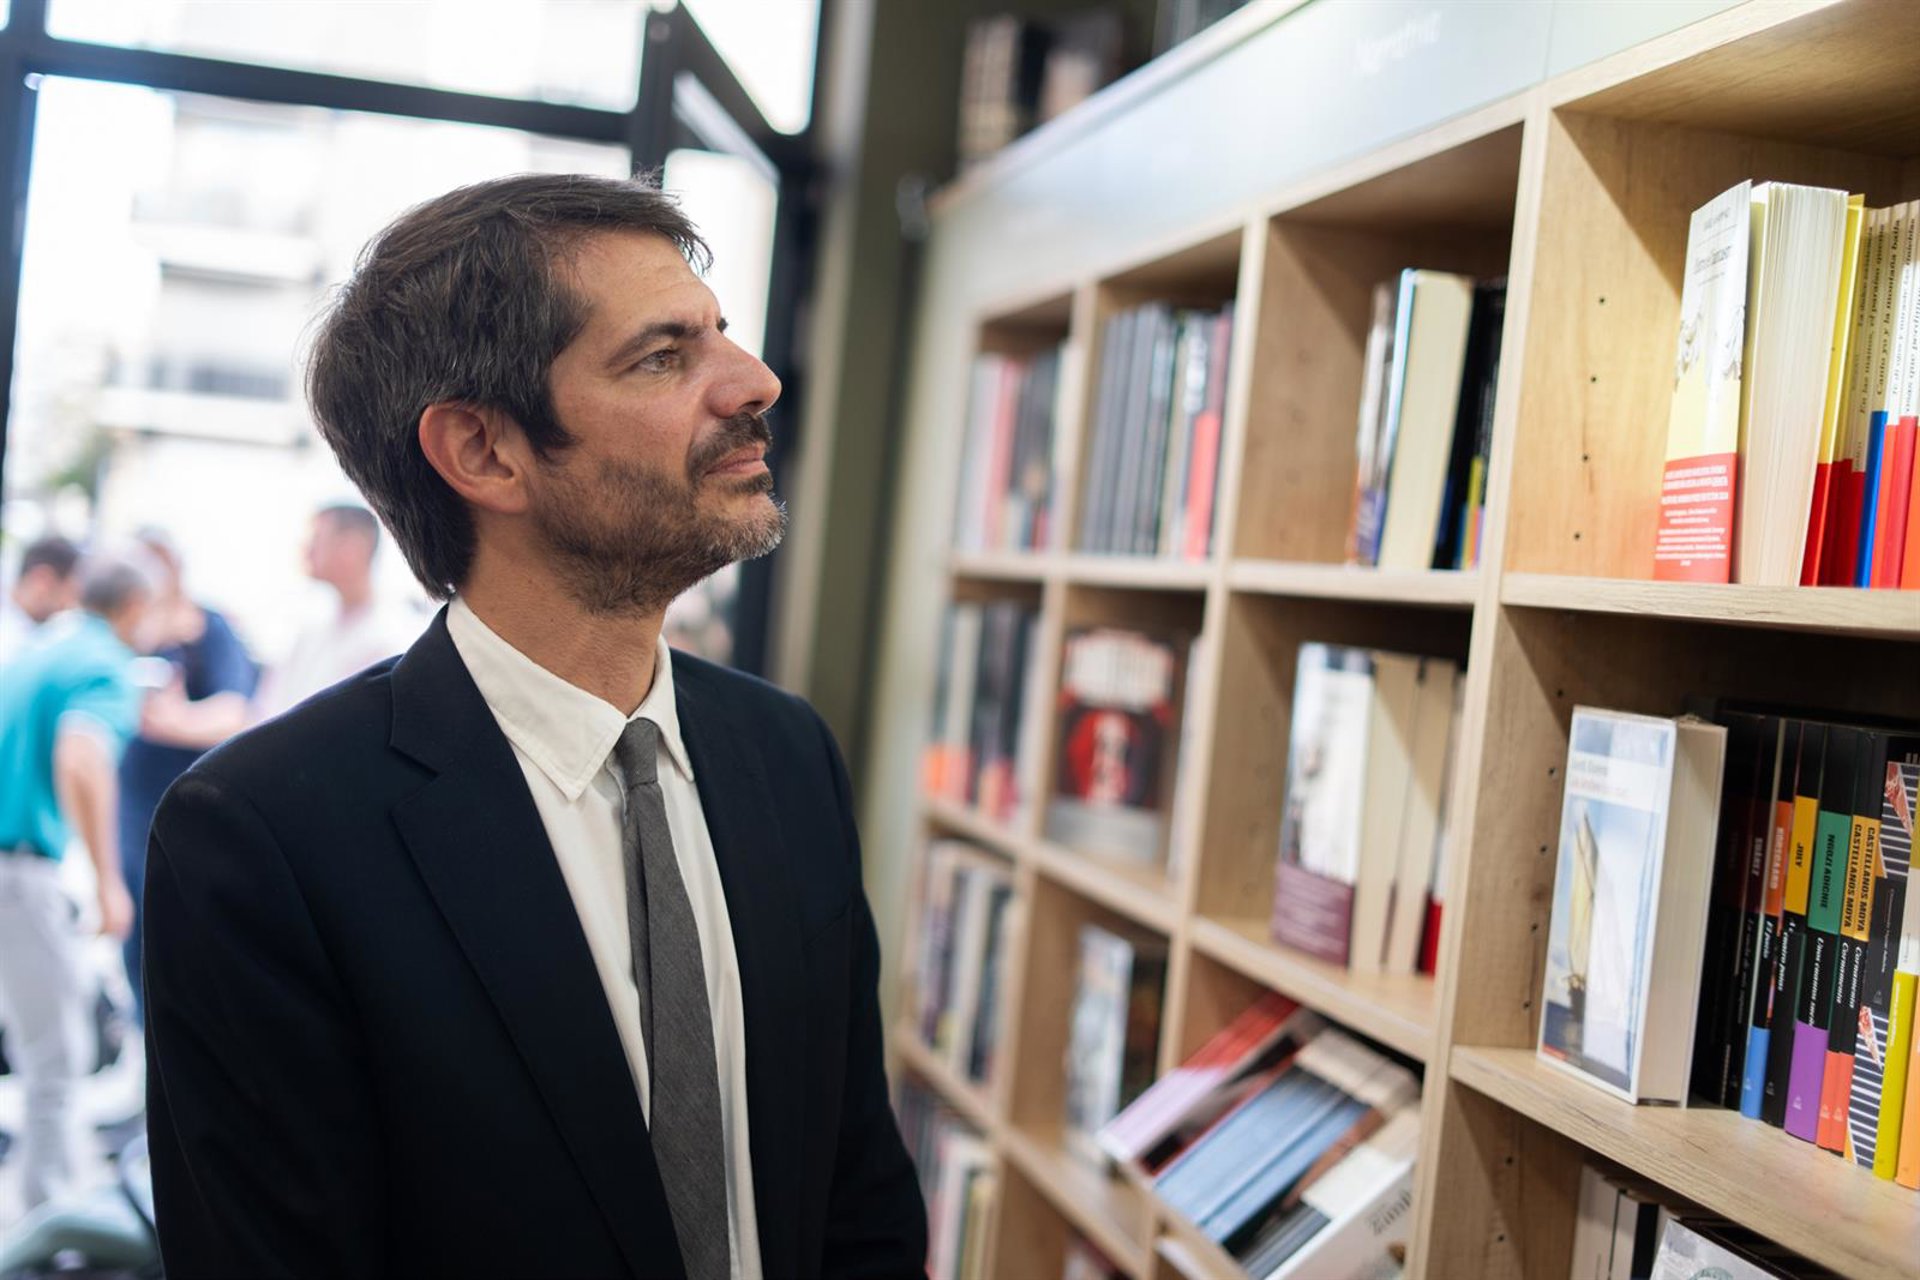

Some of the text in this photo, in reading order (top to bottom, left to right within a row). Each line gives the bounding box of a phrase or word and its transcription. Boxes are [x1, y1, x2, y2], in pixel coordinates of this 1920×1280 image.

[1891, 219, 1901, 250] baila
[1886, 254, 1897, 309] montaña
[1883, 312, 1891, 324] la
[1881, 338, 1889, 355] yo
[1876, 357, 1886, 396] Canto
[1795, 842, 1805, 868] JULY
[1819, 833, 1836, 909] NGOZI ADICHIE
[1843, 823, 1863, 929] CASTELLANOS MOYA
[1857, 826, 1876, 932] CASTELLANOS MOYA
[1815, 936, 1824, 962] Unos
[1811, 962, 1820, 1000] cuantos
[1836, 942, 1849, 1005] Cornamenta
[1849, 946, 1862, 1009] Cornamenta
